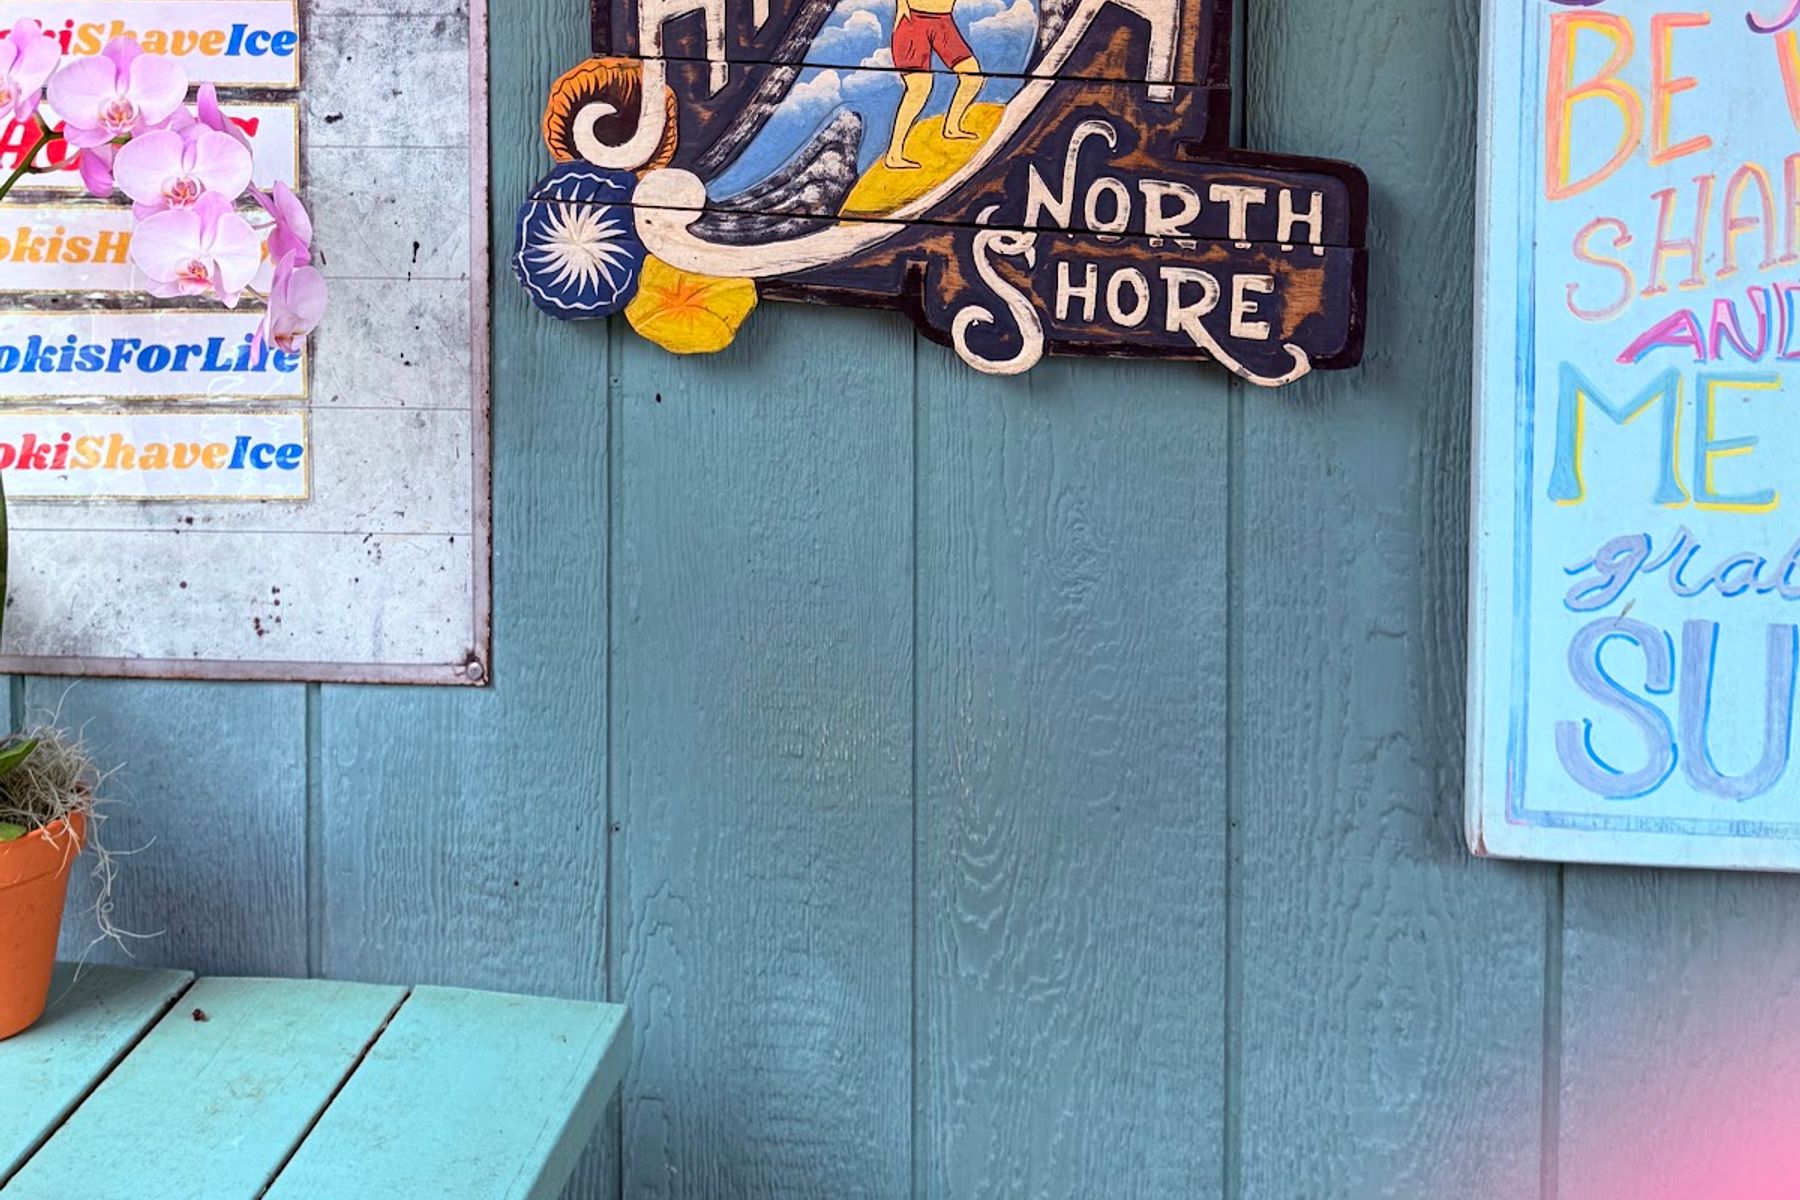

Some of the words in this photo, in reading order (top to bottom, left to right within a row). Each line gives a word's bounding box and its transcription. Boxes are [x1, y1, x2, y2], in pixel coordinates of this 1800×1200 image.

[1021, 119, 1325, 257] NORTH
[1545, 10, 1713, 202] BE
[951, 205, 1312, 387] SHORE
